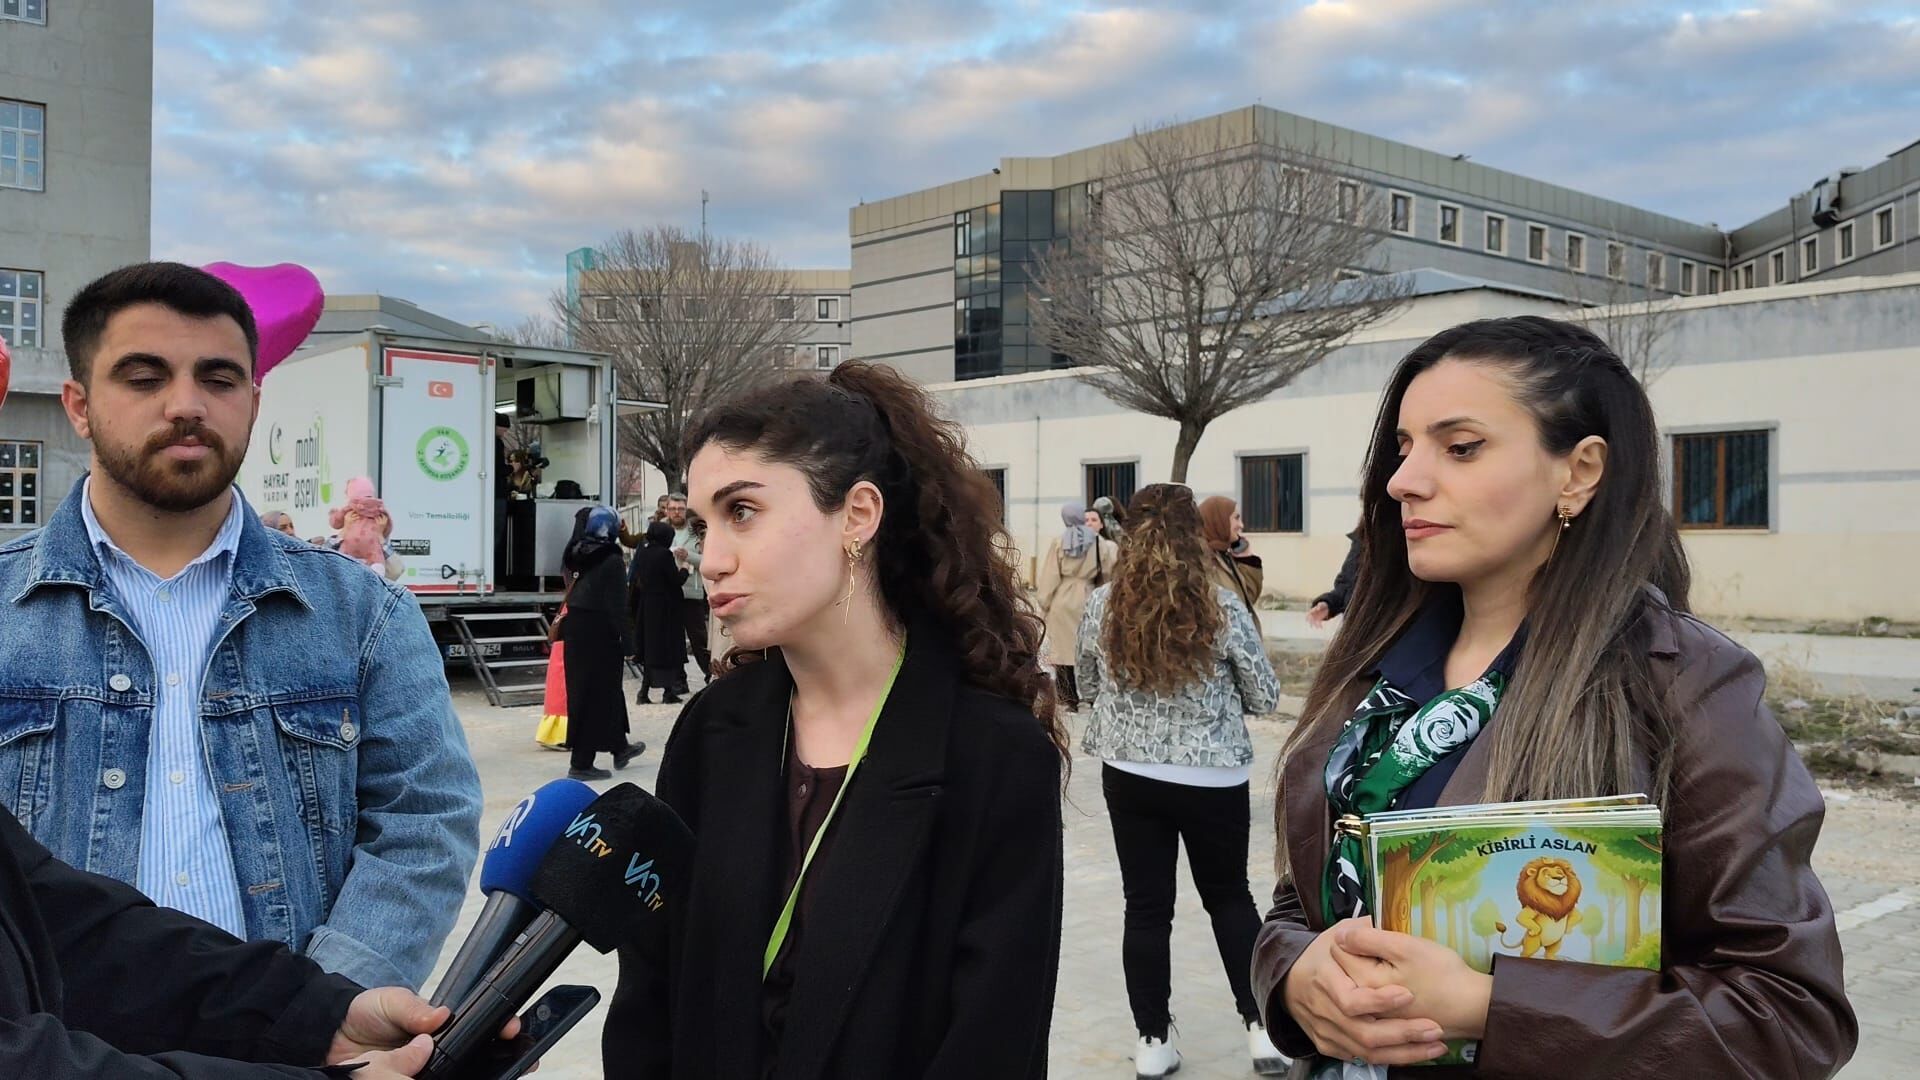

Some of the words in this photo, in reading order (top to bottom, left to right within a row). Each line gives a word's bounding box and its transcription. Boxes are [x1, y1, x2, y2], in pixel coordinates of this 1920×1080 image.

[263, 473, 289, 489] HAYRAT
[1476, 834, 1536, 857] KİBİRLİ
[1540, 838, 1598, 855] ASLAN
